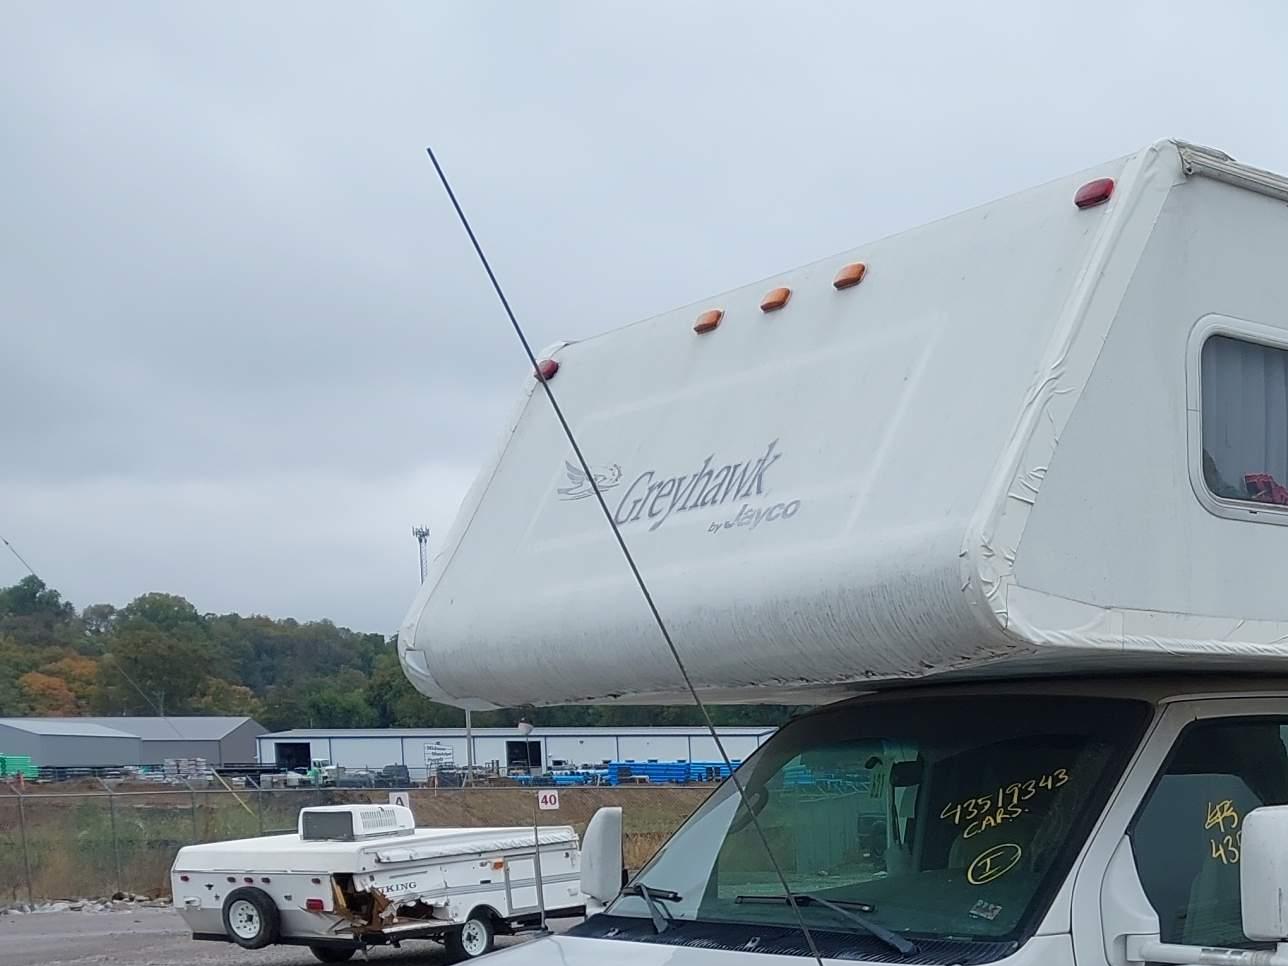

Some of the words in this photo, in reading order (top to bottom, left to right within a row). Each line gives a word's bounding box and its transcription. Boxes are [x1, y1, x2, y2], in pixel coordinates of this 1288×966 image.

[615, 438, 782, 531] Greyhawk
[707, 521, 723, 534] by
[724, 499, 800, 530] Jayco
[396, 796, 405, 807] A
[541, 794, 557, 806] 40
[940, 768, 1069, 824] 43519343
